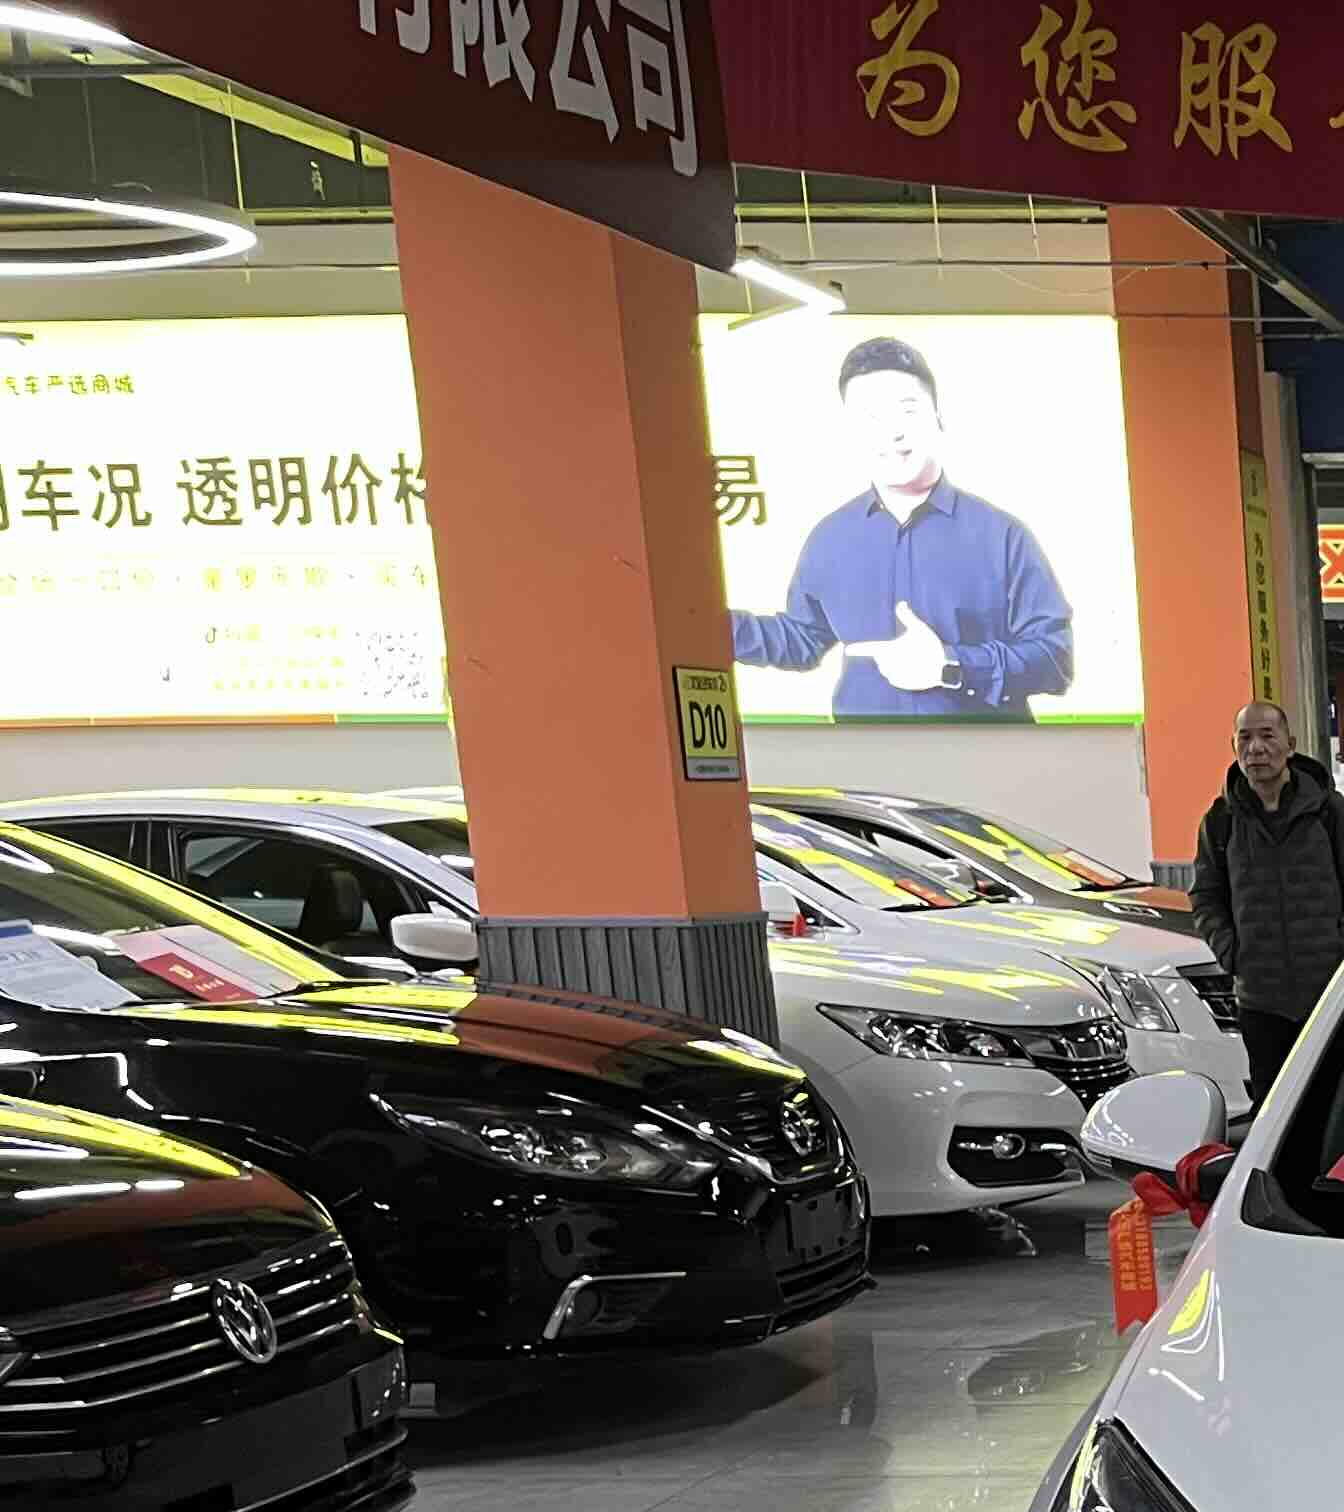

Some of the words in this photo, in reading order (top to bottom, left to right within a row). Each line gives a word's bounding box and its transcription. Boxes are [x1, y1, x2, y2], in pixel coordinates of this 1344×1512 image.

[358, 0, 697, 176] 限公司
[0, 459, 152, 532] 车况
[689, 700, 728, 750] D10
